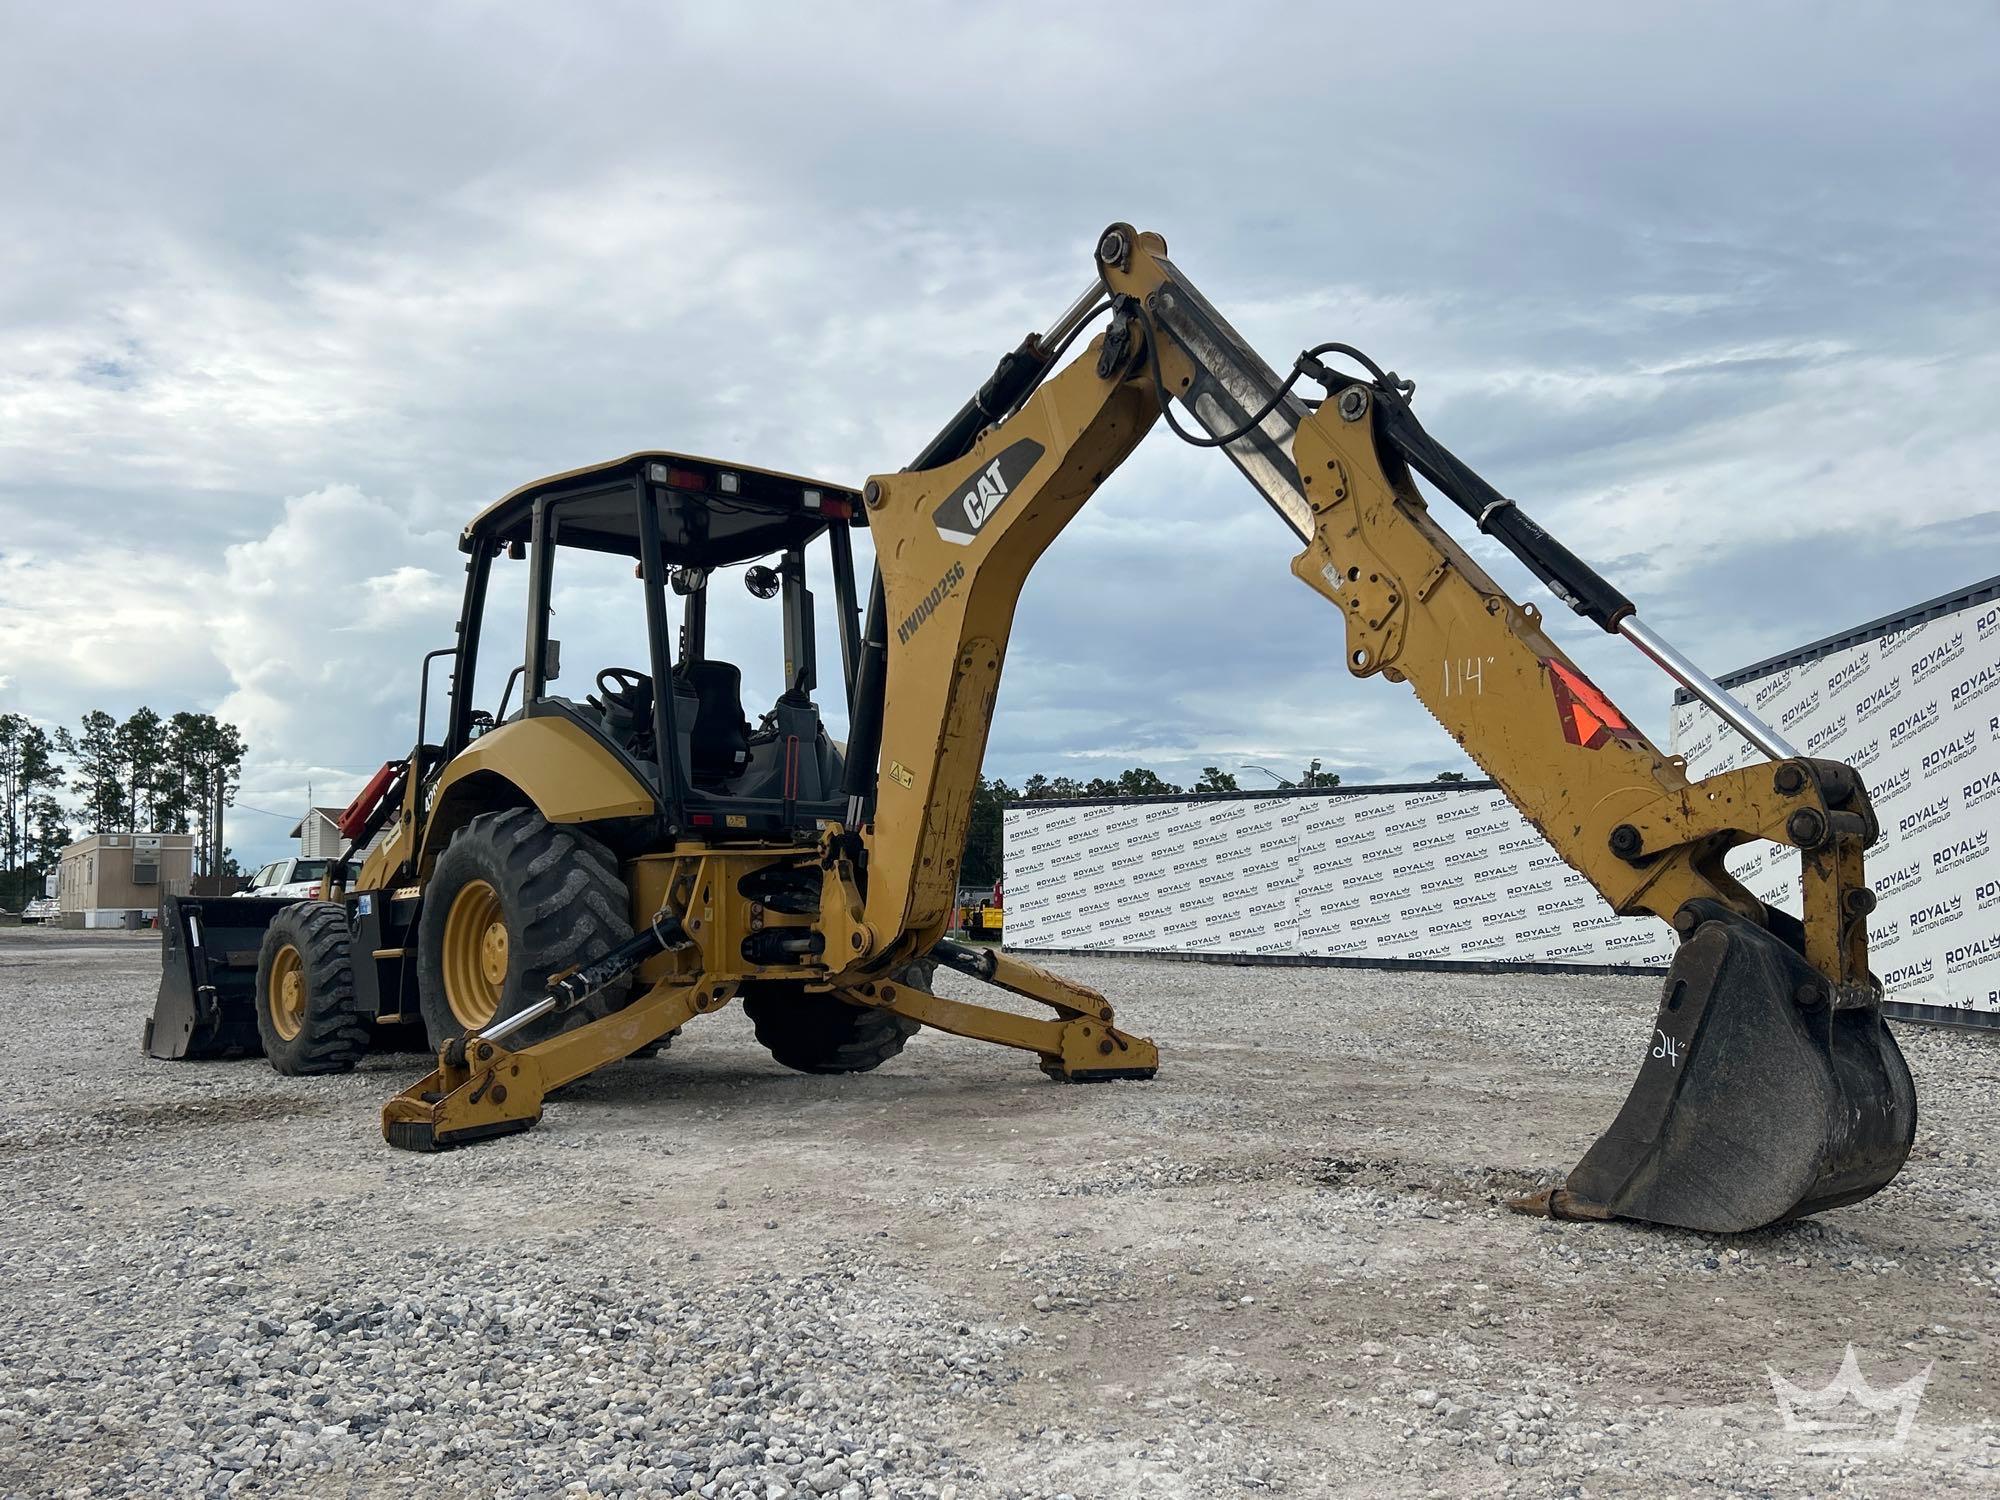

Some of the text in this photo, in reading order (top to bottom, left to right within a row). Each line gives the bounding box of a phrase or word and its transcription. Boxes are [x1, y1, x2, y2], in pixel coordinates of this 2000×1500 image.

[963, 458, 1008, 529] CAT
[896, 560, 965, 646] HWD00256
[1881, 640, 1906, 660] AUCTION
[1911, 642, 1951, 677] ROYAL
[1914, 645, 1964, 686] AUCTION GROUP
[1828, 659, 1860, 691] ROYAL
[1830, 663, 1871, 699] AUCTION GROUP
[1755, 676, 1783, 704] ROYAL
[1951, 666, 1995, 702] ROYAL
[1855, 684, 1891, 716] ROYAL
[1954, 686, 1983, 711] AUCTION
[1782, 697, 1811, 725] ROYAL
[1858, 688, 1902, 724] AUCTION GROUP
[1889, 709, 1927, 741] ROYAL
[1807, 721, 1838, 750] ROYAL
[1891, 713, 1939, 750] AUCTION GROUP
[1844, 746, 1870, 767] OYAL
[1922, 738, 1964, 770] ROYAL
[1925, 743, 1977, 779] AUCTION GROUP
[1891, 781, 1912, 799] GROUP
[1963, 772, 2000, 800] ROYA
[1253, 798, 1282, 810] ROYAL
[1404, 794, 1438, 806] ROYAL
[1965, 788, 1996, 810] AUCTION
[1083, 807, 1107, 818] ROYAL
[1145, 808, 1171, 820] ROYAL
[1354, 806, 1386, 818] ROYAL
[1436, 808, 1470, 820] ROYAL
[1899, 803, 1938, 833] ROYAL
[1106, 819, 1131, 830] ROYAL
[1167, 822, 1194, 833] ROYAL
[1235, 823, 1264, 835] ROYAL
[1305, 818, 1336, 830] ROYAL
[1384, 820, 1417, 832] ROYAL
[1465, 823, 1500, 835] ROYAL
[1901, 810, 1950, 842] AUCTION GROUP
[1009, 828, 1032, 839] ROYAL
[1335, 832, 1366, 844] ROYAL
[1031, 841, 1054, 851] ROYAL
[1192, 835, 1219, 846] ROYAL
[1259, 837, 1288, 849] ROYAL
[1412, 836, 1445, 848] ROYAL
[1498, 838, 1533, 850] ROYAL
[1088, 843, 1113, 854] ROYAL
[1215, 849, 1243, 860] ROYAL
[1361, 848, 1394, 859] ROYAL
[1870, 842, 1890, 857] GROUP
[1933, 837, 1976, 866] ROYAL
[1444, 850, 1478, 863] ROYAL
[1936, 844, 1989, 876] AUCTION GROUP
[1014, 864, 1037, 874] ROYAL
[1242, 862, 1270, 873] ROYAL
[1313, 859, 1343, 870] ROYAL
[1392, 862, 1425, 874] ROYAL
[1473, 866, 1508, 878] ROYAL
[1036, 876, 1059, 886] ROYAL
[1342, 874, 1374, 885] ROYAL
[1420, 878, 1454, 890] ROYAL
[1874, 867, 1911, 893] ROYAL
[1222, 888, 1250, 898] ROYAL
[1506, 882, 1542, 894] ROYAL
[1876, 874, 1923, 902] AUCTION GROUP
[1056, 890, 1079, 900] ROYAL
[1117, 893, 1142, 903] ROYAL
[1369, 889, 1401, 901] ROYAL
[1452, 894, 1487, 905] ROYAL
[1759, 887, 1780, 903] OYAL
[1248, 902, 1277, 913] ROYAL
[1320, 900, 1351, 911] ROYAL
[1400, 905, 1433, 916] ROYAL
[1537, 899, 1574, 911] ROYAL
[1138, 908, 1164, 918] ROYAL
[1481, 910, 1517, 922] ROYAL
[1910, 901, 1950, 927] ROYAL
[1005, 921, 1028, 930] ROYAL
[1350, 915, 1381, 926] ROYAL
[1428, 921, 1462, 932] ROYAL
[1572, 916, 1610, 928] ROYAL
[1912, 909, 1963, 936] AUCTION GROUP
[1163, 922, 1190, 932] ROYAL
[1229, 927, 1257, 937] ROYAL
[1301, 925, 1332, 936] ROYAL
[1515, 927, 1551, 938] ROYAL
[1377, 931, 1409, 942] ROYAL
[1605, 934, 1644, 946] ROYAL
[1869, 926, 1890, 943] YAL
[1186, 936, 1213, 947] ROYAL
[1327, 941, 1358, 952] ROYAL
[1460, 938, 1495, 949] ROYAL
[1881, 935, 1900, 949] GROUP
[1407, 947, 1441, 958] ROYAL
[1546, 945, 1583, 956] ROYAL
[1946, 939, 1989, 965] ROYAL
[1948, 958, 1977, 975] AUCTION
[1884, 962, 1922, 986] ROYAL
[1887, 972, 1934, 995] AUCTION GROUP
